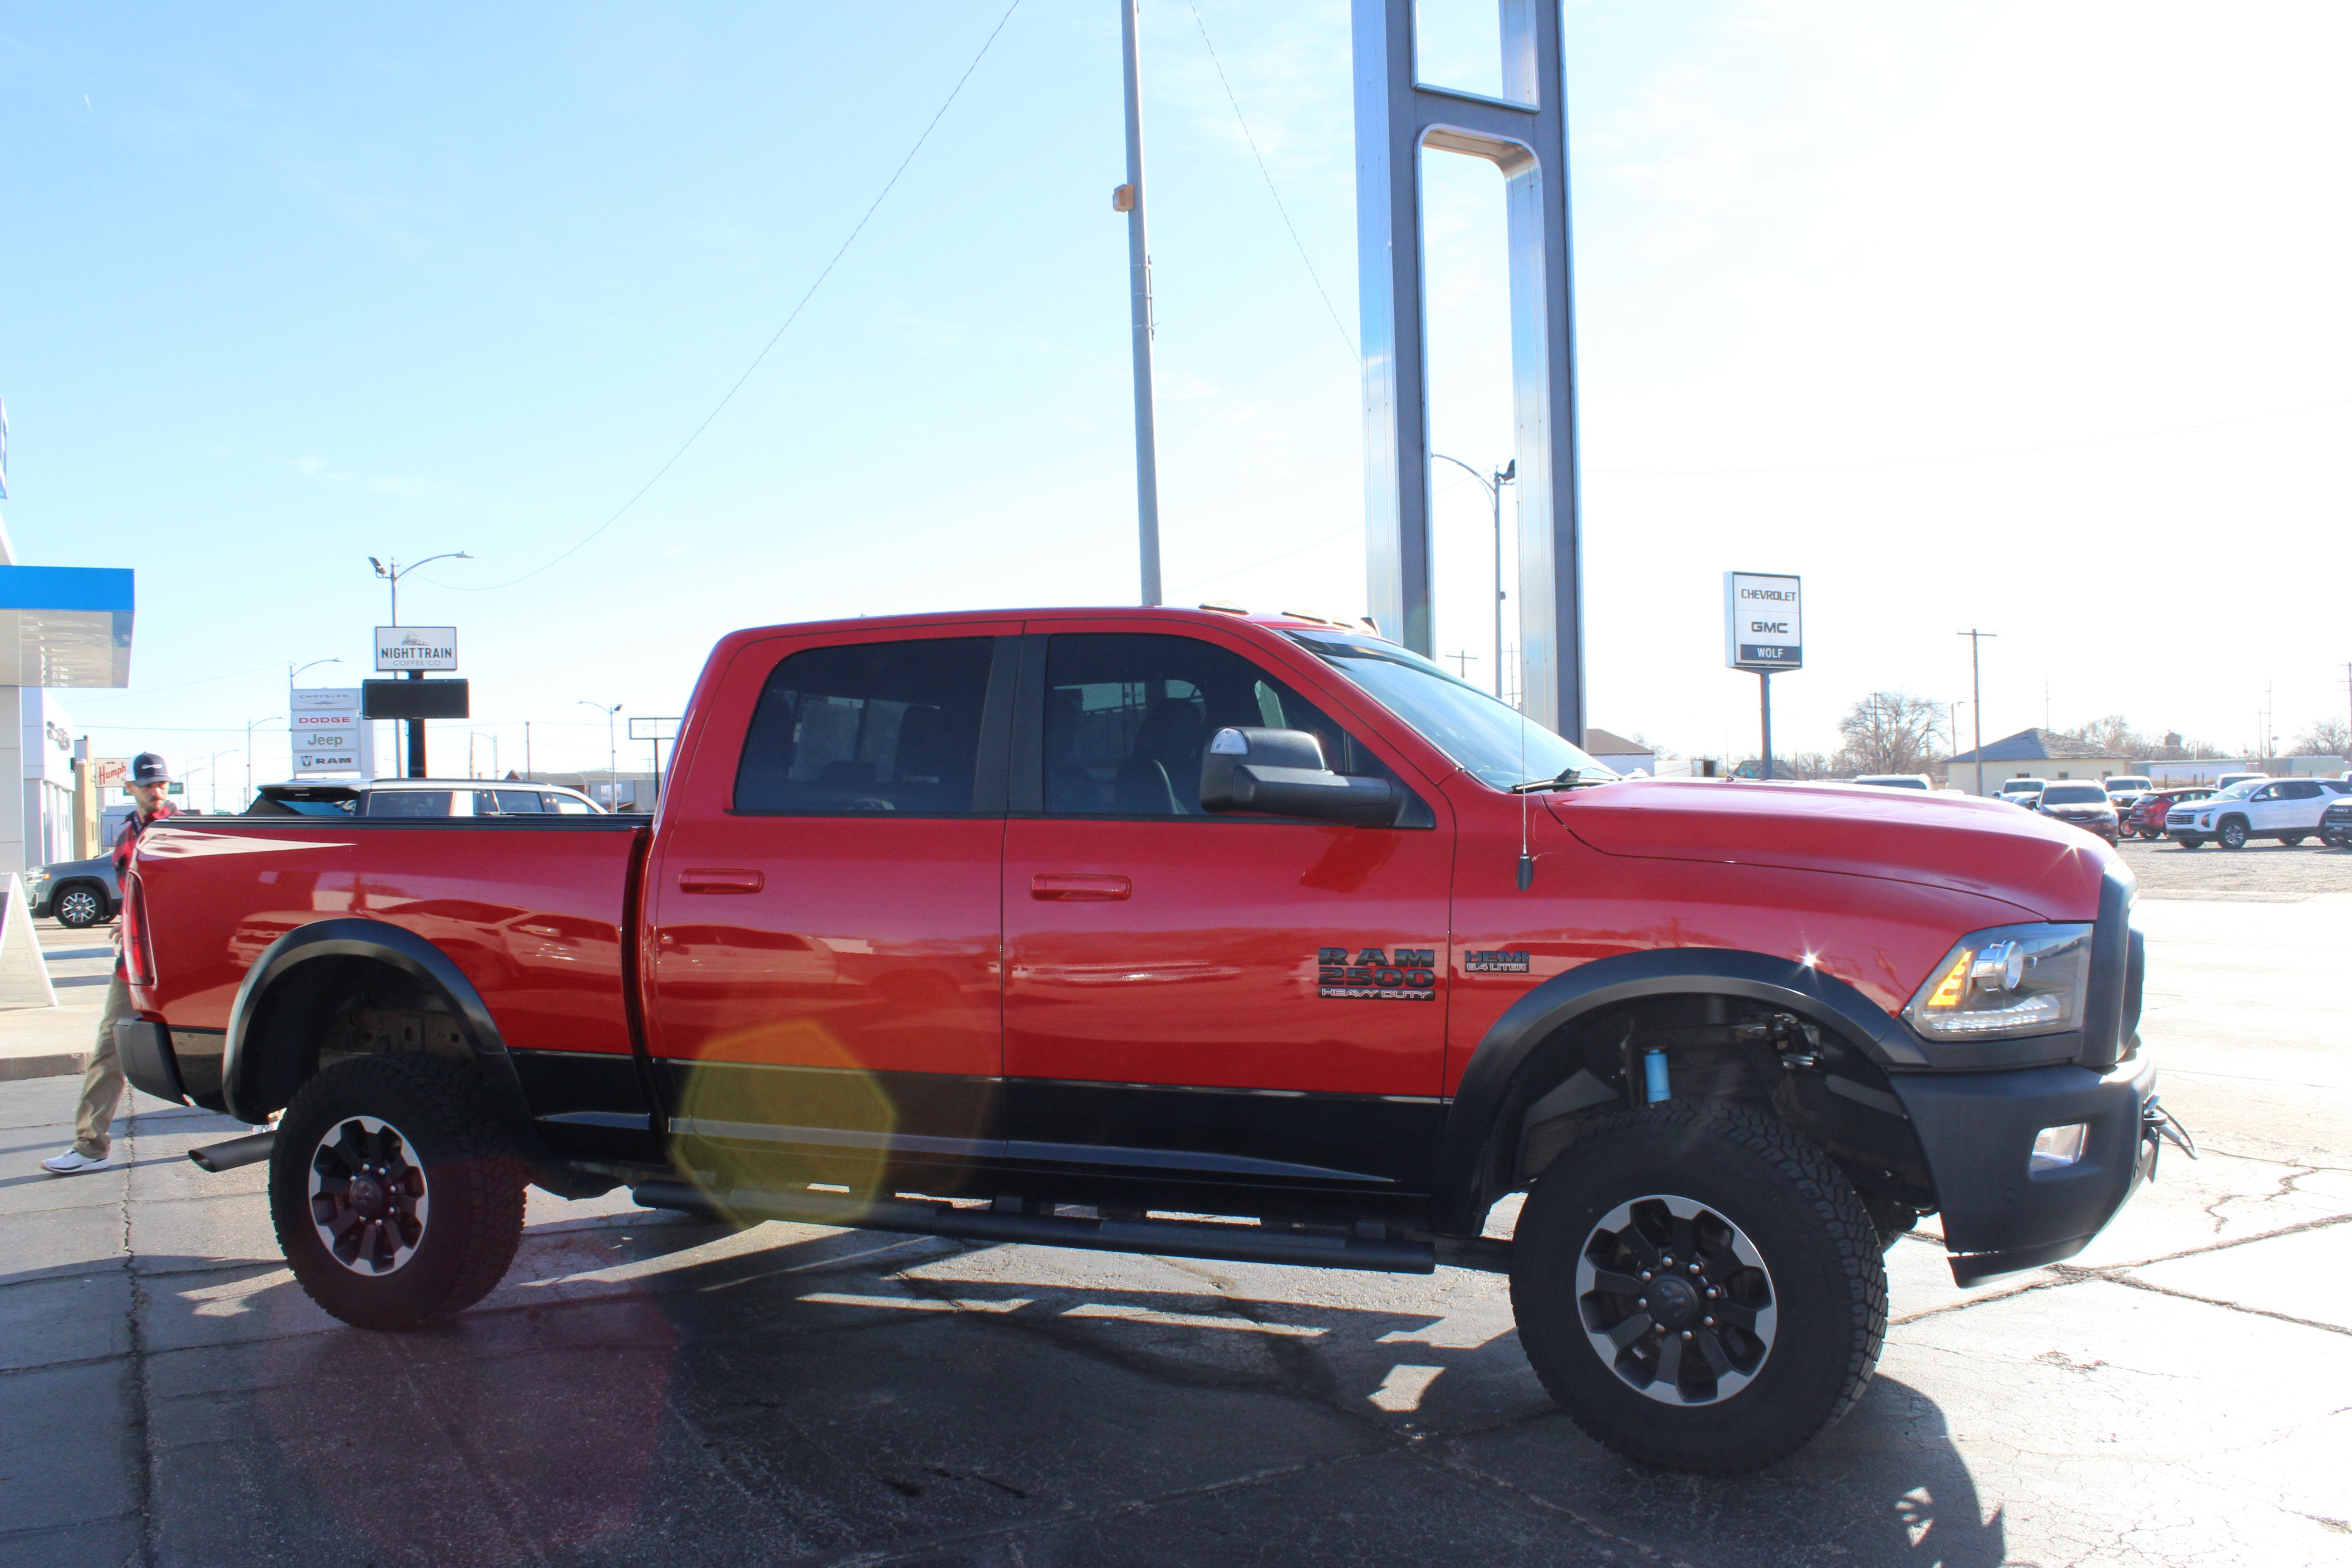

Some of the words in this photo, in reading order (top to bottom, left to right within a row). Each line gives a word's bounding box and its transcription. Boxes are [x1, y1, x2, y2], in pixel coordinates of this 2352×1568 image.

[1741, 589, 1796, 601] CHEVROLET
[1751, 621, 1788, 633] GMC
[381, 647, 416, 658] NIGHT
[417, 647, 452, 658] TRAIN
[1757, 647, 1784, 658] WOLF
[308, 734, 343, 747] Jeep
[98, 762, 126, 785] Humph
[1318, 947, 1435, 967] RAM
[1465, 951, 1529, 962] HEMI
[1318, 967, 1435, 988] 2500
[1322, 989, 1378, 997] HEAVY
[1382, 990, 1430, 999] DUTY
